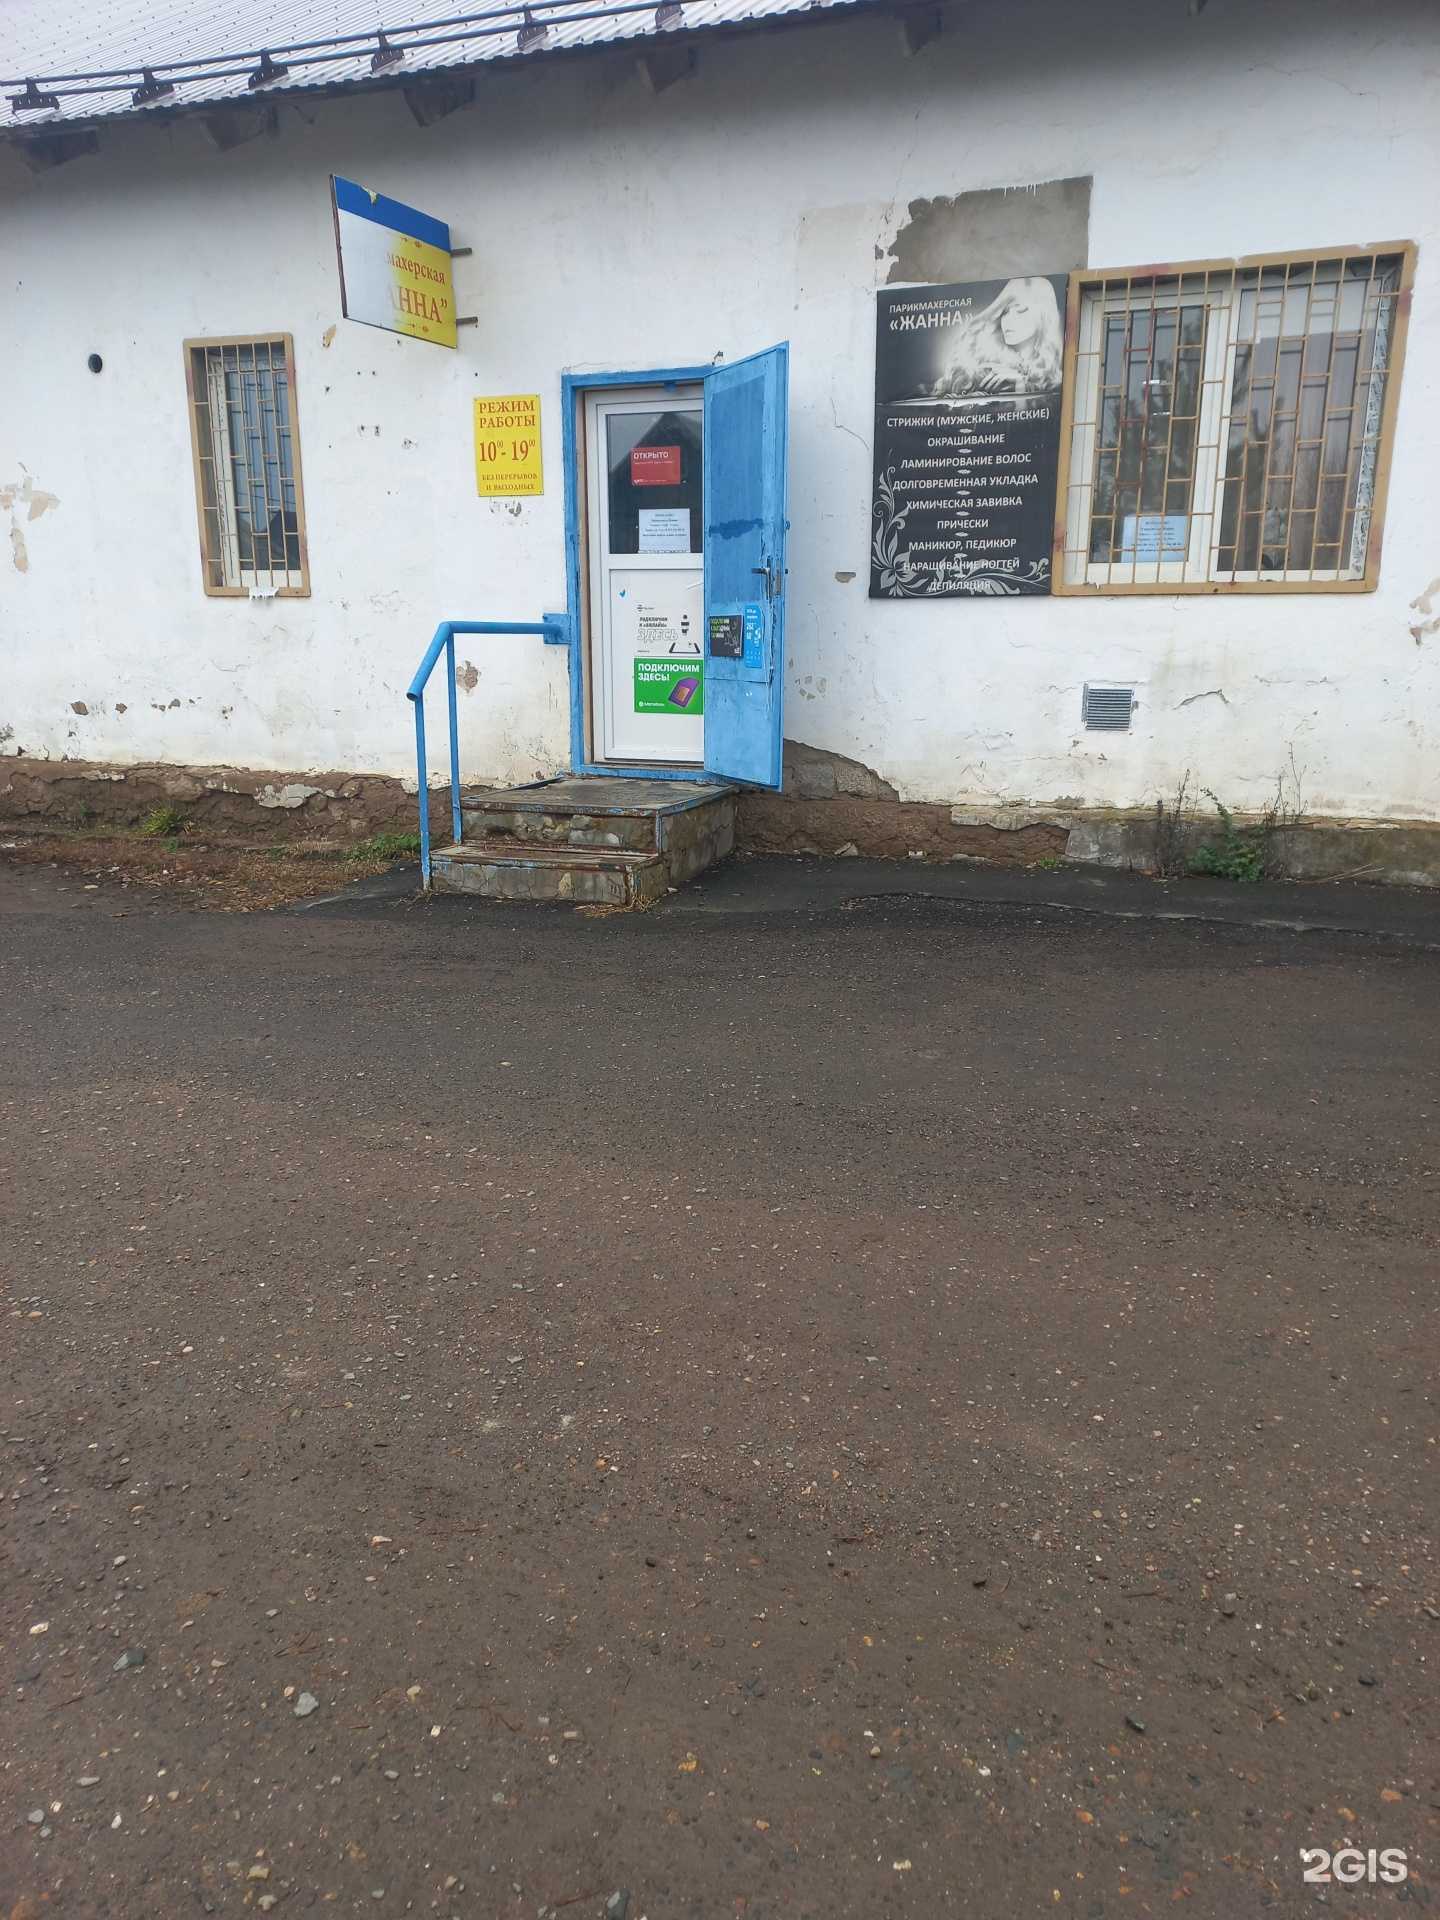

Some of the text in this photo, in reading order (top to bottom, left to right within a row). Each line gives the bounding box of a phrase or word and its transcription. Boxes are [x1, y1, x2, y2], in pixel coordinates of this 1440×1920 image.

[386, 252, 446, 285] махерская
[889, 297, 972, 313] ПАРИКМАХЕРСКАЯ
[889, 310, 973, 331] «ЖАННА»
[479, 400, 535, 414] РЕЖИМ
[480, 415, 535, 428] РАБОТЫ
[887, 408, 1050, 427] СТРИЖКИ (МУЖСКИЕ, ЖЕНСКИЕ)
[927, 433, 1005, 447] ОКРАШИВАНИЕ
[633, 451, 669, 460] ОТКРЫТО
[901, 453, 1032, 469] ЛАМИНИРОВАНИЕ ВОЛОС
[893, 473, 1039, 491] ДОЛГОВРЕМЕННАЯ УКЛАДКА
[906, 496, 1023, 510] ХИМИЧЕСКАЯ ЗАВИВКА
[937, 519, 989, 530] ПРИЧЕСКИ
[908, 538, 1017, 551] МАНИКЮР, ПЕДИКЮР
[903, 557, 1020, 571] НАРАЩИВАНИЕ НОГТЕЙ
[928, 580, 991, 592] ДЕПИЛЯЦИЯ
[638, 663, 700, 673] ПОДКЛЮЧИМ
[637, 672, 670, 682] ЗДЕСЬ!
